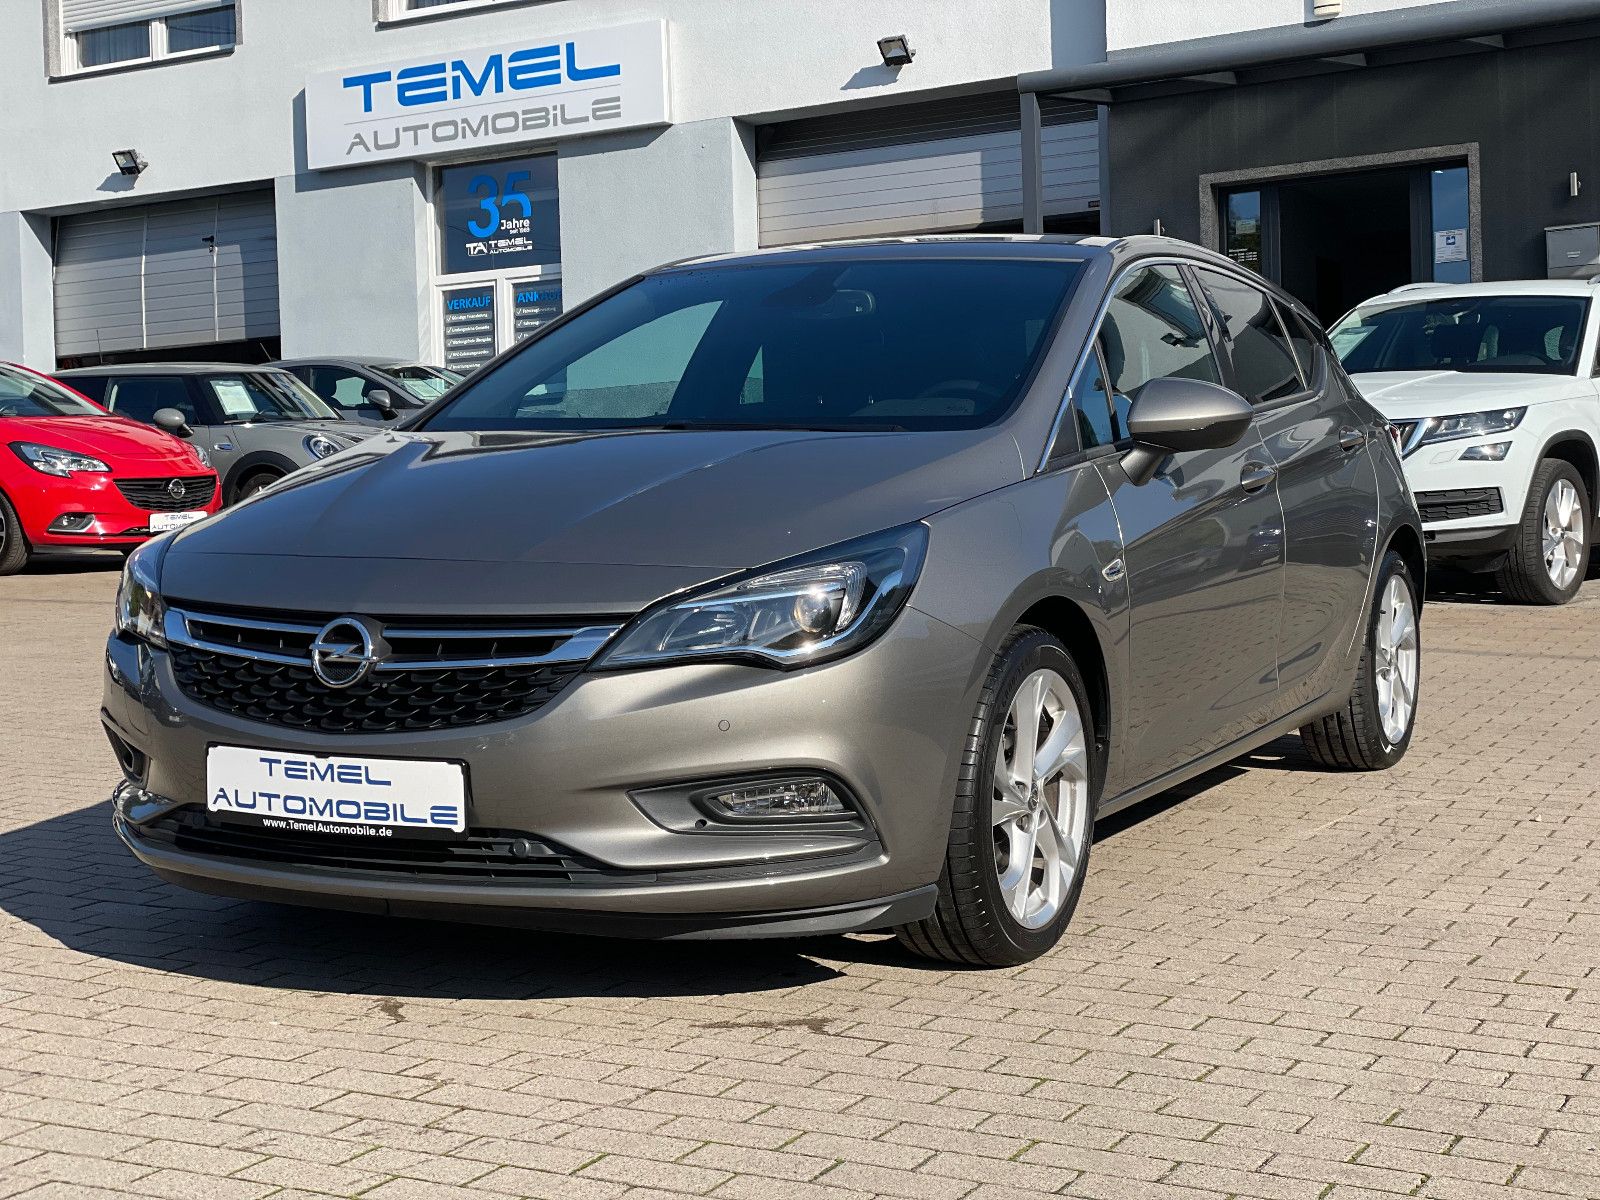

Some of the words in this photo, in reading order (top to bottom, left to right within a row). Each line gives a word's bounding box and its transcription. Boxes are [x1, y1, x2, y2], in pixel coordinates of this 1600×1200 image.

[342, 42, 621, 113] TEMEL
[467, 170, 532, 238] 35
[500, 217, 530, 230] Jahre
[488, 236, 533, 248] TEMEL
[447, 296, 491, 311] VERKAUF
[259, 757, 392, 786] TEMEL
[212, 787, 458, 825] AUTOMOBILE
[262, 817, 393, 837] www.TemelAutomobile.de
